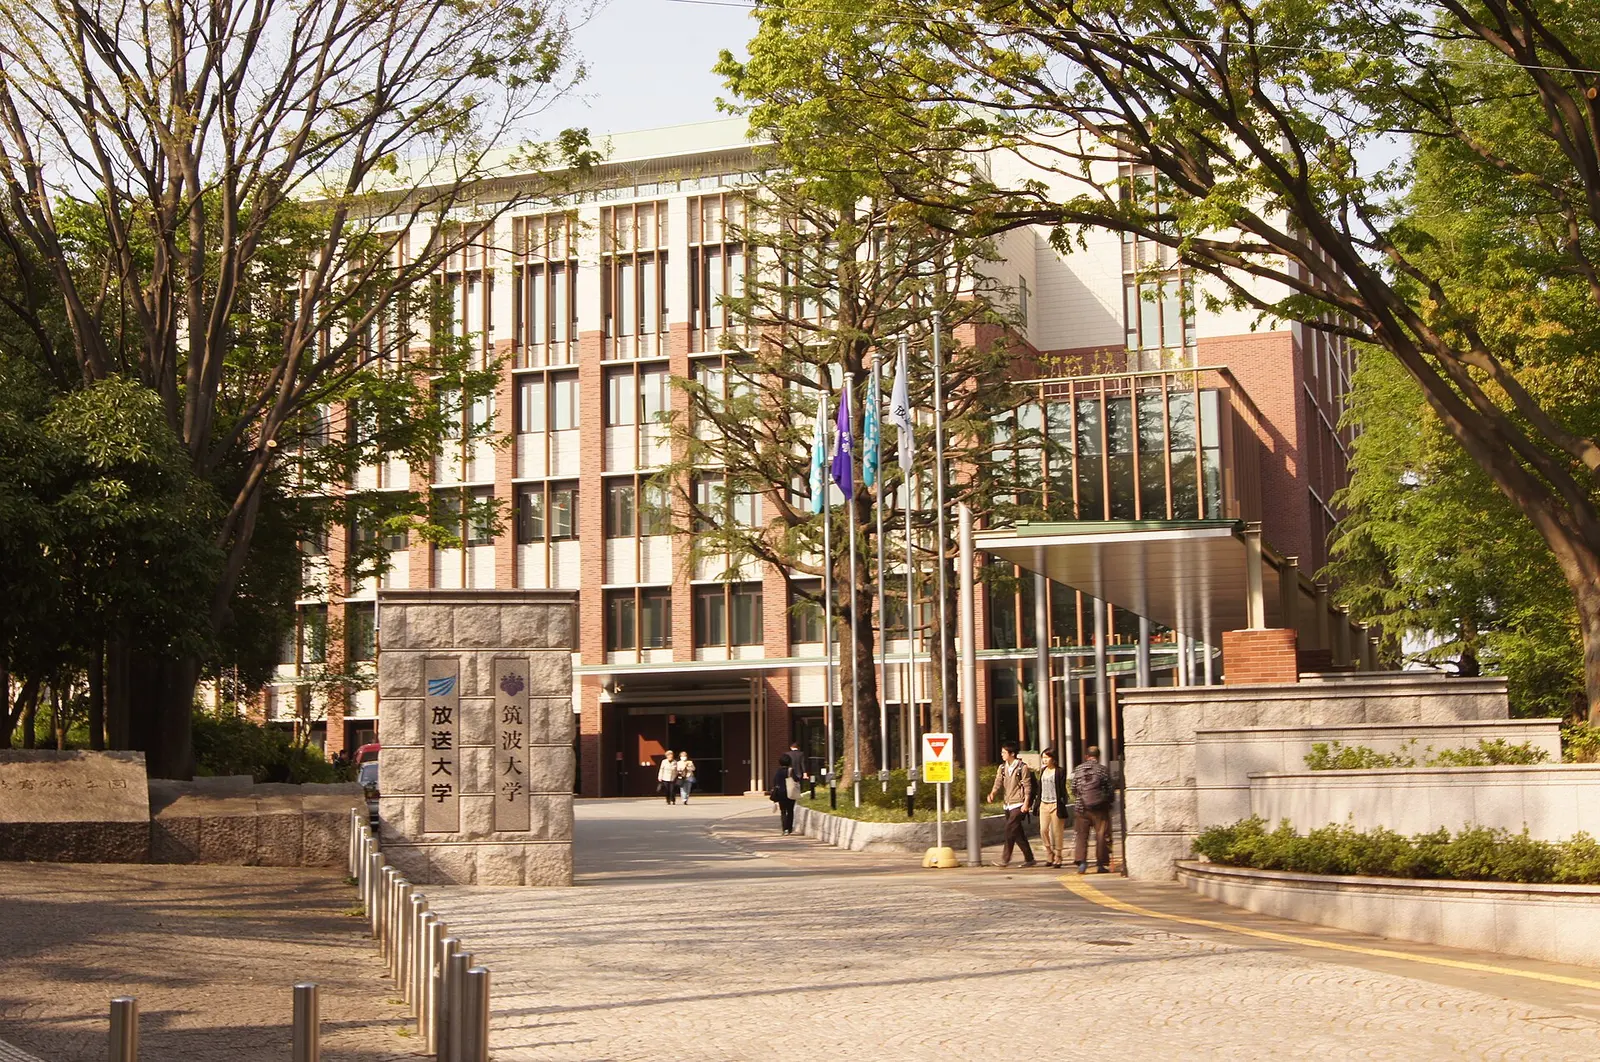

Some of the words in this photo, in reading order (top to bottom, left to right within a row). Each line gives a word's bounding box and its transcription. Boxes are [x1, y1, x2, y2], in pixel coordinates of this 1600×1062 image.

[431, 706, 453, 803] 放送大学
[502, 705, 523, 802] 筑波大学
